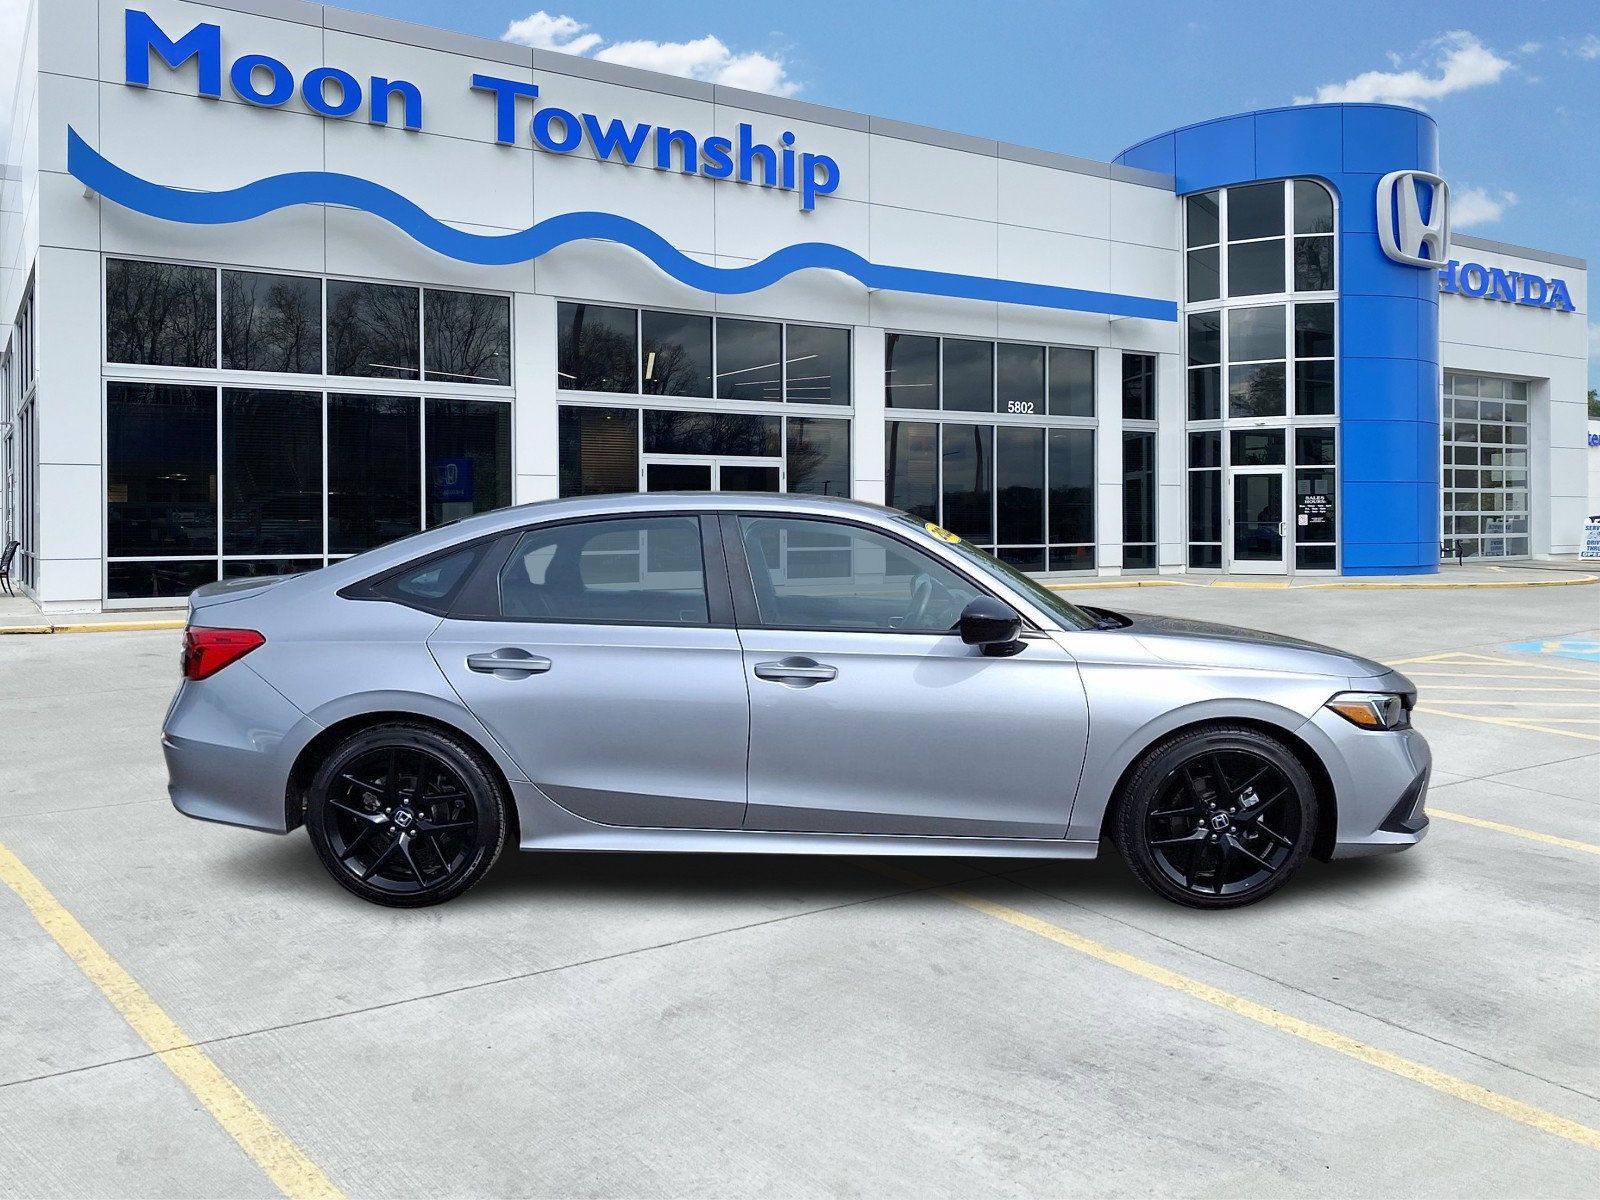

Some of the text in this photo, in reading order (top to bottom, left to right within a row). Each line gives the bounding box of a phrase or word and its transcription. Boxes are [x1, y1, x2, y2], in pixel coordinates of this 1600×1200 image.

[124, 8, 841, 212] Moon Township
[1438, 259, 1576, 312] HONDA
[1007, 400, 1034, 414] 5802
